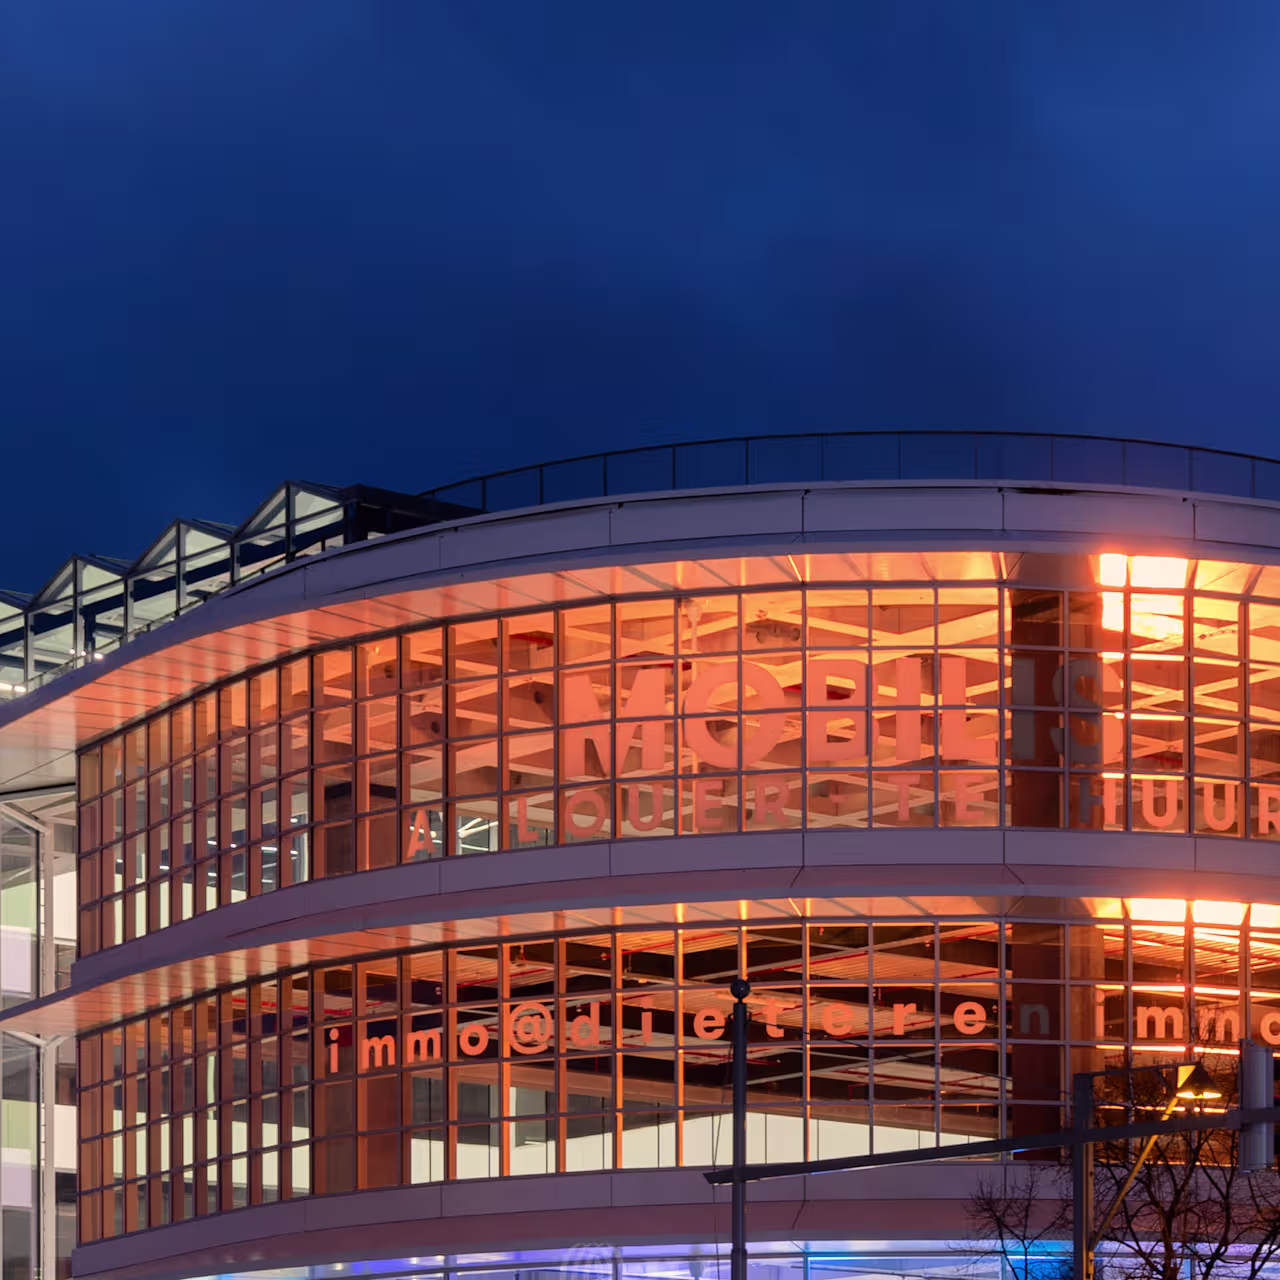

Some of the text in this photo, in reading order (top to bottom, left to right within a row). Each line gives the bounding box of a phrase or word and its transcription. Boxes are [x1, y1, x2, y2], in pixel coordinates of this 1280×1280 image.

[562, 657, 1125, 780] MOBILIS
[516, 775, 790, 843] LOUER
[886, 772, 986, 822] TE
